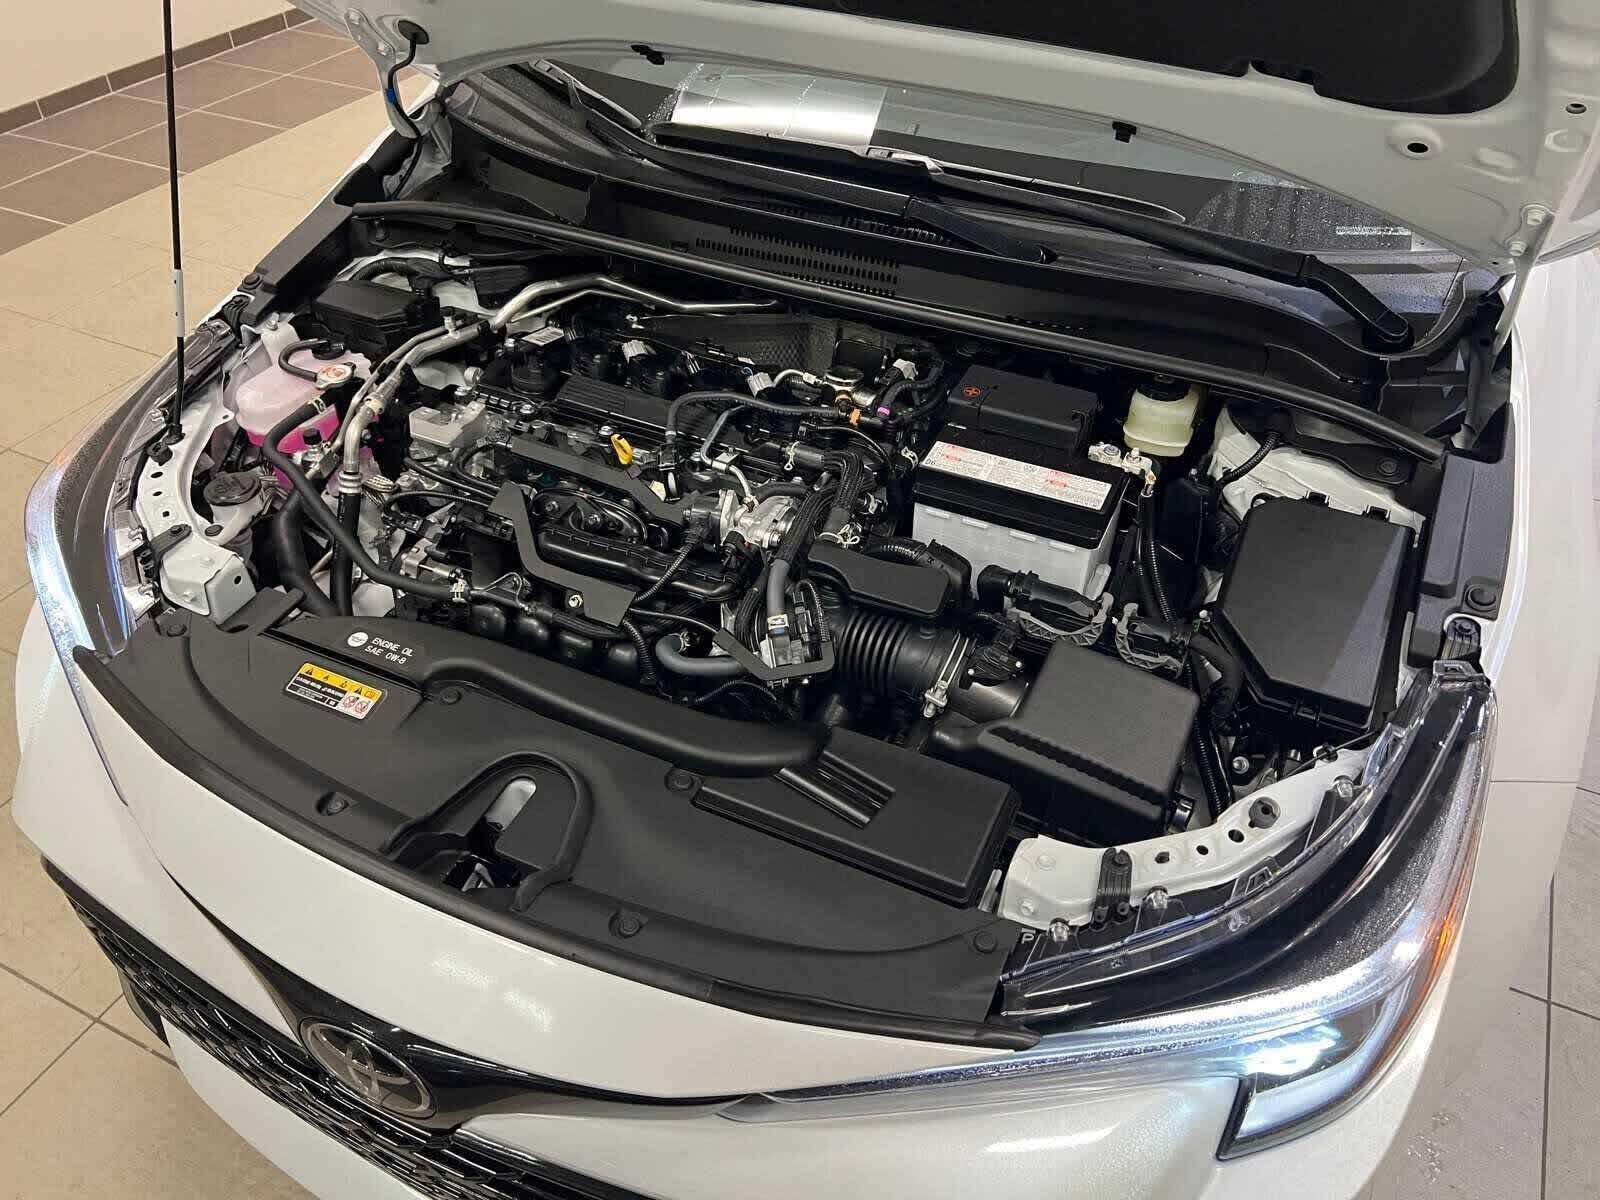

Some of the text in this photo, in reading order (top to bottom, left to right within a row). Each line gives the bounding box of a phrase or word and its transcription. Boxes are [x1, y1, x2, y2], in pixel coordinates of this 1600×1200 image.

[364, 645, 384, 656] SAE
[371, 637, 400, 652] ENGINE
[401, 647, 413, 657] OIL
